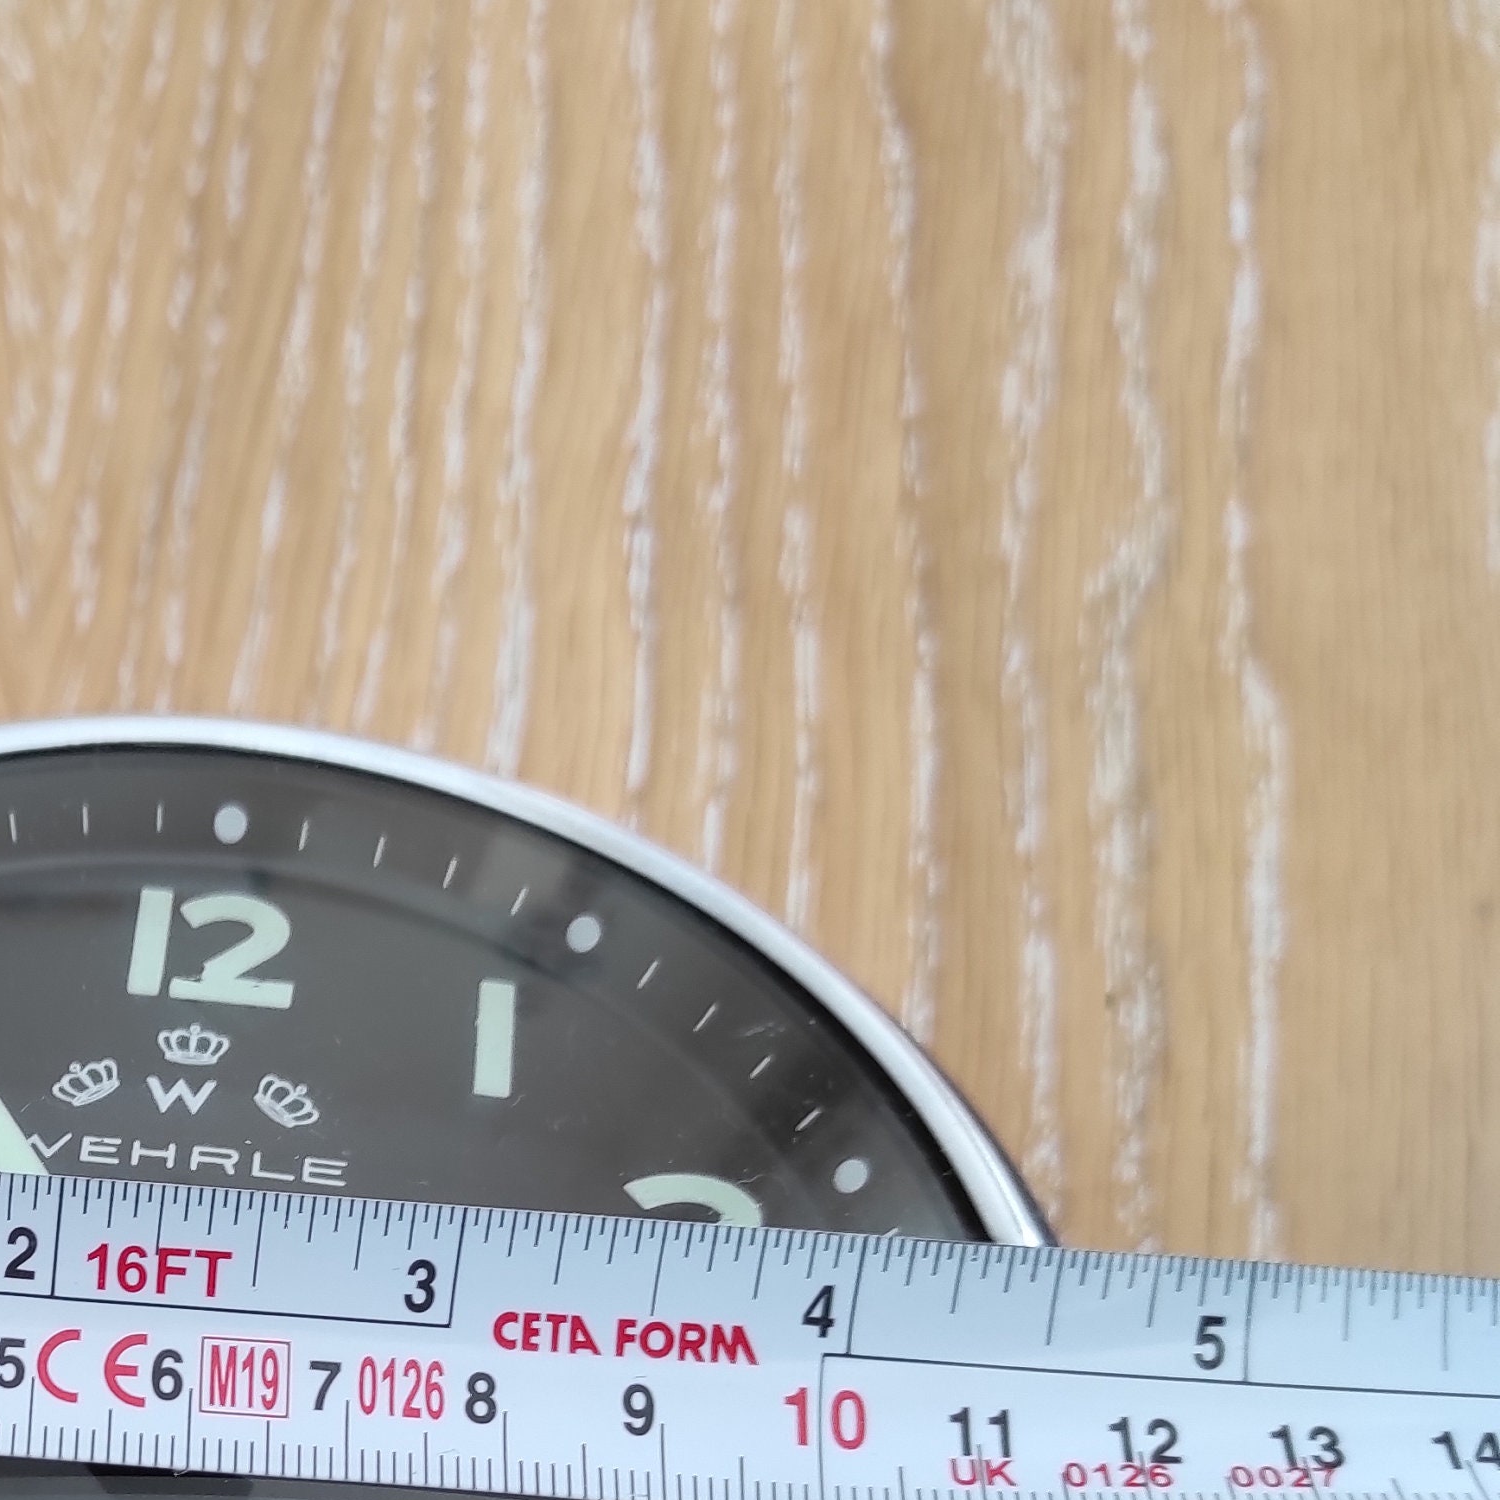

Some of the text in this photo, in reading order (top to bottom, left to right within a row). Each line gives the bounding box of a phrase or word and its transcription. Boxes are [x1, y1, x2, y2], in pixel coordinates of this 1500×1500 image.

[126, 886, 295, 1009] 12
[473, 978, 516, 1099] 1
[146, 1076, 217, 1114] W
[4, 1227, 37, 1281] 2
[86, 1243, 233, 1298] 16FT
[403, 1259, 437, 1313] 3
[801, 1285, 836, 1338] 4
[493, 1311, 760, 1366] CETA FORM
[1194, 1316, 1226, 1369] 5
[150, 1350, 184, 1401] 6
[209, 1346, 281, 1411] M19
[309, 1360, 342, 1411] 7
[358, 1355, 446, 1420] 0126
[464, 1372, 497, 1424] 8
[622, 1383, 655, 1436] 9
[784, 1386, 868, 1451] 10
[949, 1407, 1012, 1458] 11
[1109, 1416, 1182, 1465] 12
[1271, 1424, 1346, 1470] 13
[1432, 1430, 1500, 1471] 14
[950, 1458, 1338, 1489] UK 0126 0027
